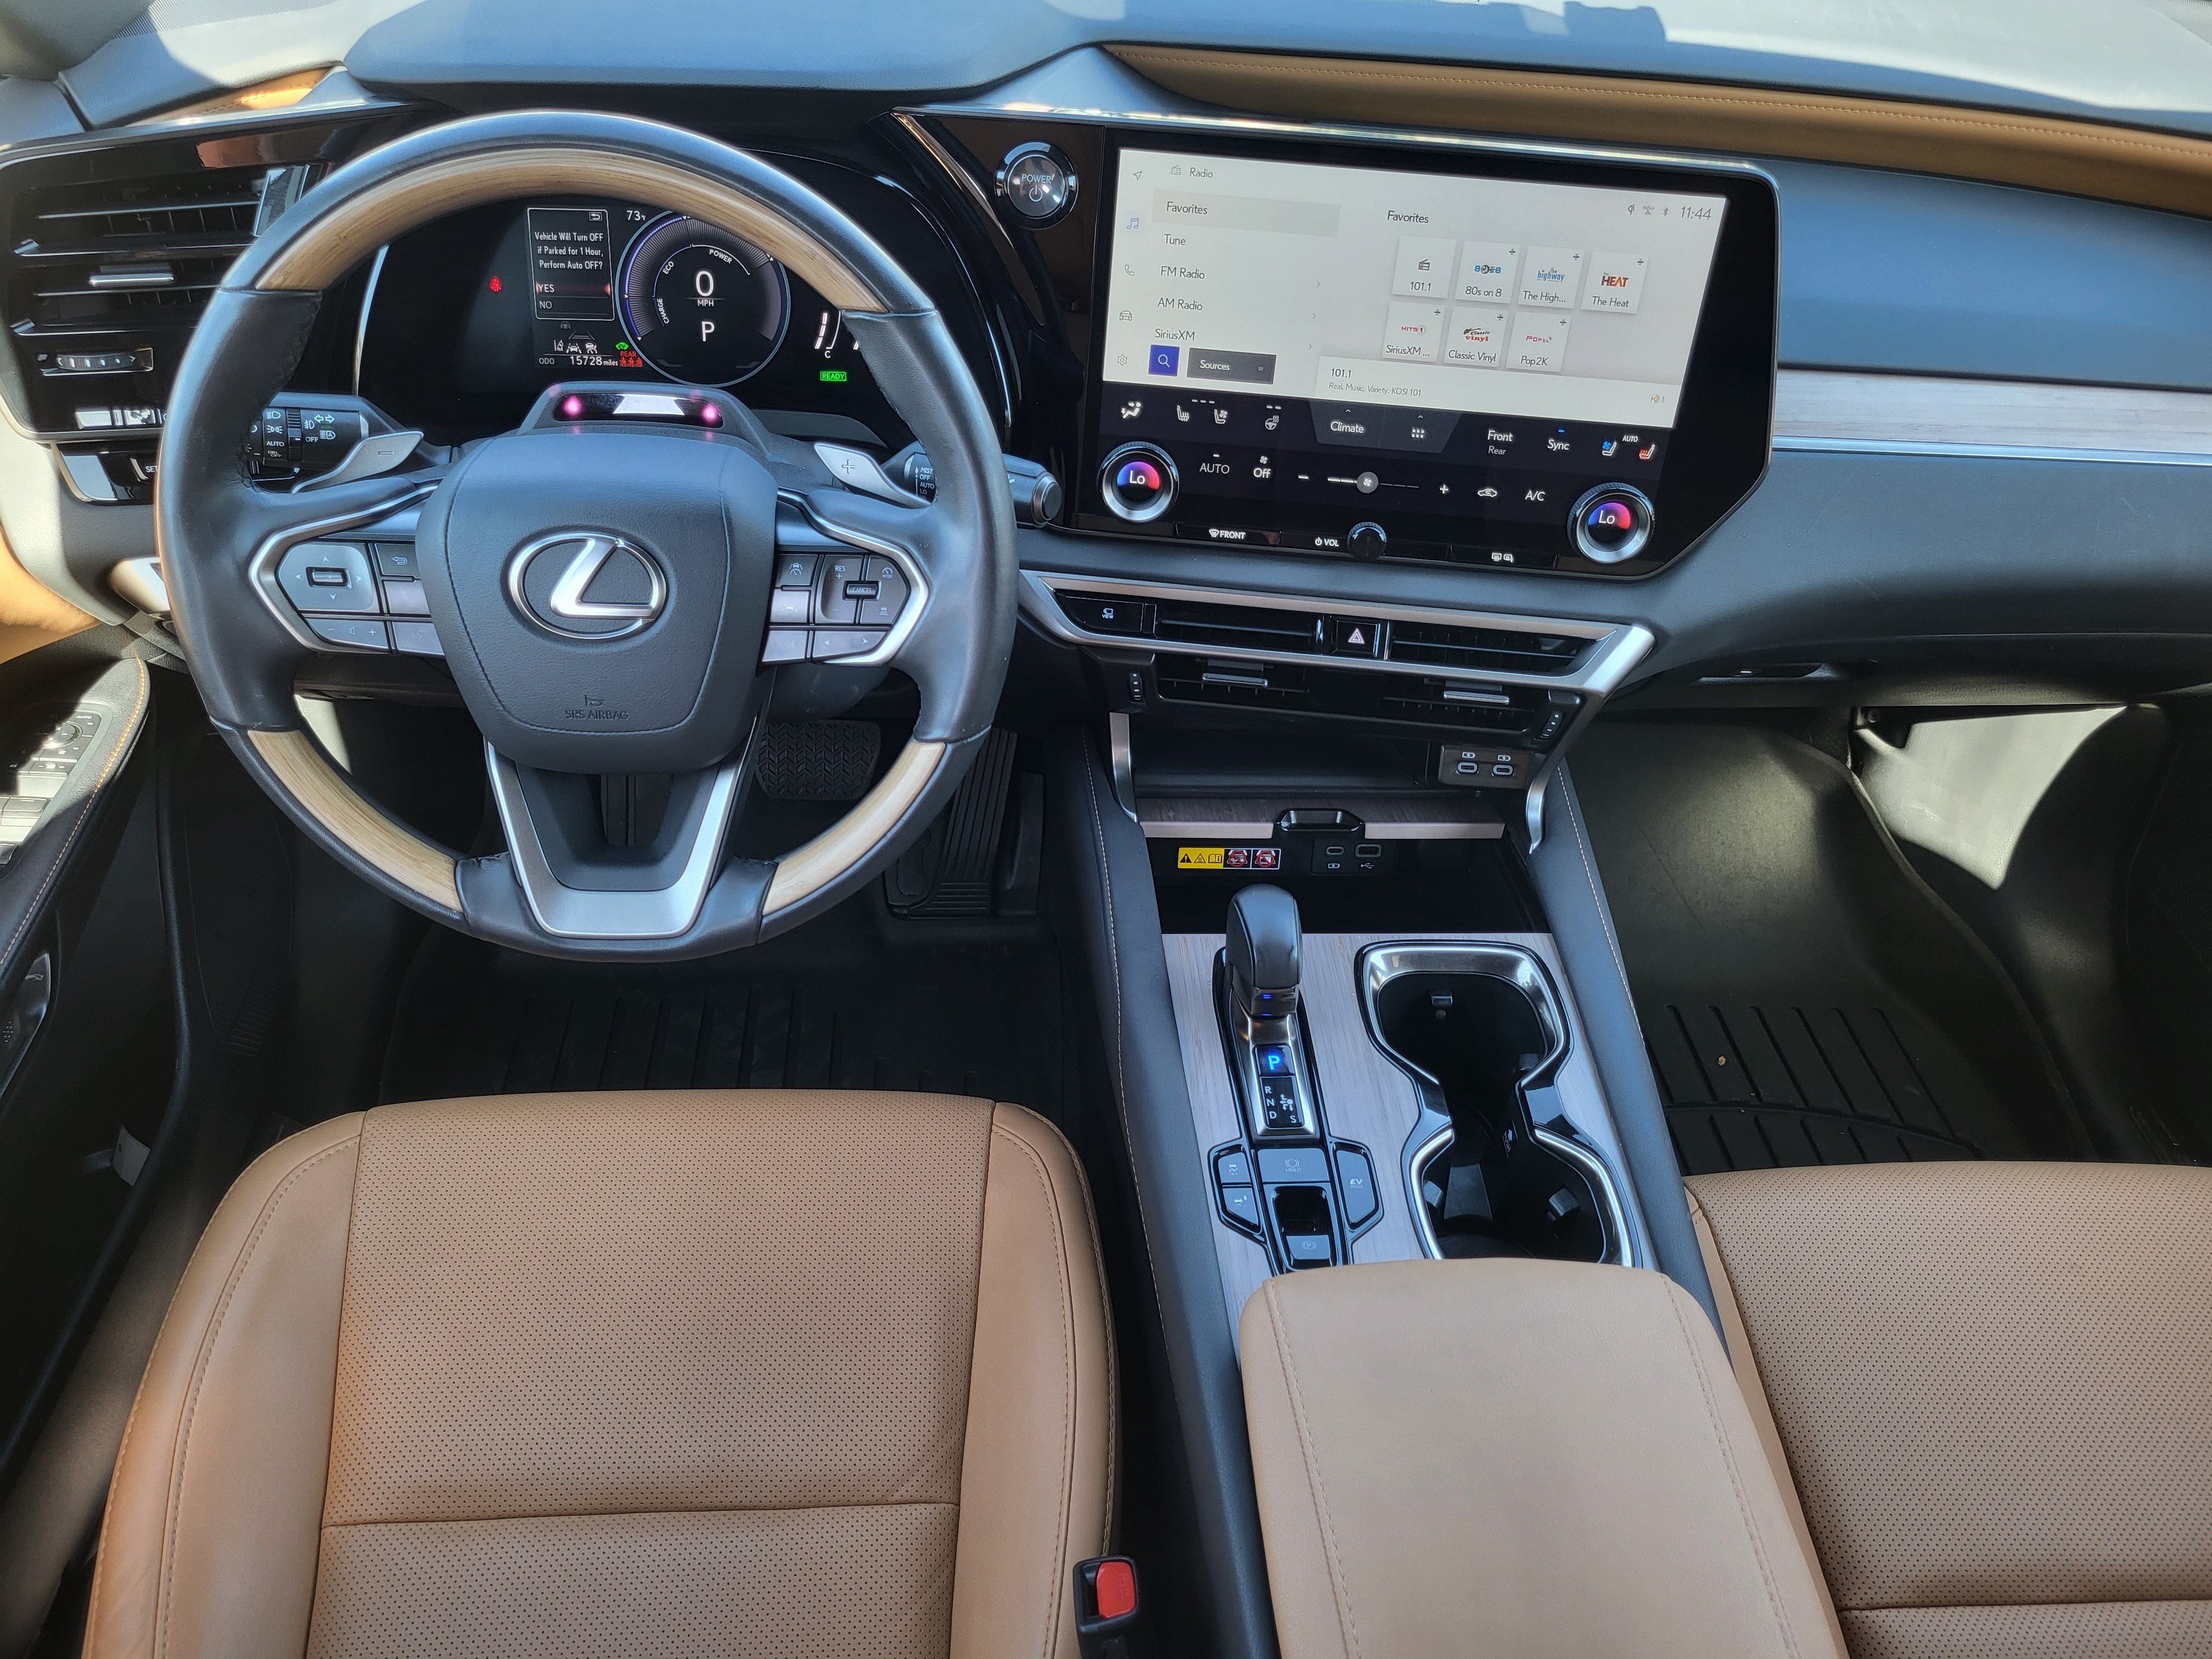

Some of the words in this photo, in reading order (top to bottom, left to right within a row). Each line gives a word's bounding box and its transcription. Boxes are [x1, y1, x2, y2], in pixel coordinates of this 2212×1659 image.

[1021, 174, 1051, 184] POWER
[1190, 167, 1213, 179] Radio
[1166, 201, 1208, 215] Favorites
[1681, 206, 1712, 220] 11:44
[1387, 210, 1429, 223] Favorites
[535, 232, 557, 241] Vehicle
[559, 232, 571, 241] Will
[573, 233, 588, 242] Turn
[589, 233, 603, 242] OFF
[1164, 234, 1186, 246] Tune
[544, 246, 566, 255] Parked
[568, 247, 578, 255] for
[580, 247, 583, 255] 1
[585, 247, 603, 258] Hour,
[709, 249, 732, 264] POWER
[540, 260, 566, 269] Perform
[567, 260, 583, 269] Auto
[585, 261, 603, 270] OFF?
[662, 261, 674, 275] ECO
[1160, 266, 1177, 278] FM
[1180, 268, 1206, 280] Radio
[1537, 270, 1565, 282] highway
[696, 270, 714, 297] 0
[1410, 281, 1431, 291] 101.1
[1601, 275, 1629, 288] HEAT
[538, 284, 555, 293] YES
[1465, 286, 1481, 296] 80s
[1495, 288, 1502, 297] 8
[1523, 290, 1538, 300] The
[539, 300, 552, 309] NO
[1157, 297, 1175, 309] AM
[1177, 299, 1203, 311] Radio
[1592, 296, 1607, 306] The
[1609, 298, 1629, 307] Heat
[656, 298, 670, 324] CHARGE
[701, 321, 715, 342] P
[1155, 328, 1196, 341] SiriusXM
[1386, 345, 1421, 356] SiriusXM
[1448, 350, 1475, 361] Classic
[1478, 352, 1496, 363] Vinyl
[570, 356, 602, 366] 15728
[1199, 360, 1230, 371] Sources
[1521, 356, 1549, 366] Pop2K
[1331, 368, 1352, 378] 101.1
[1330, 420, 1365, 434] Climate
[1488, 430, 1513, 442] Front
[1488, 446, 1507, 455] Rear
[1547, 439, 1570, 451] Sync
[1199, 462, 1230, 475] AUTO
[1253, 467, 1271, 479] Off
[1129, 470, 1145, 484] Lo
[1525, 490, 1546, 502] A/C
[1599, 510, 1615, 524] Lo
[1219, 531, 1245, 540] FRONT
[1324, 538, 1339, 547] VOL
[565, 709, 585, 719] SRS
[588, 710, 629, 721] AIRBAG
[1268, 1055, 1280, 1070] P
[1266, 1098, 1275, 1107] N
